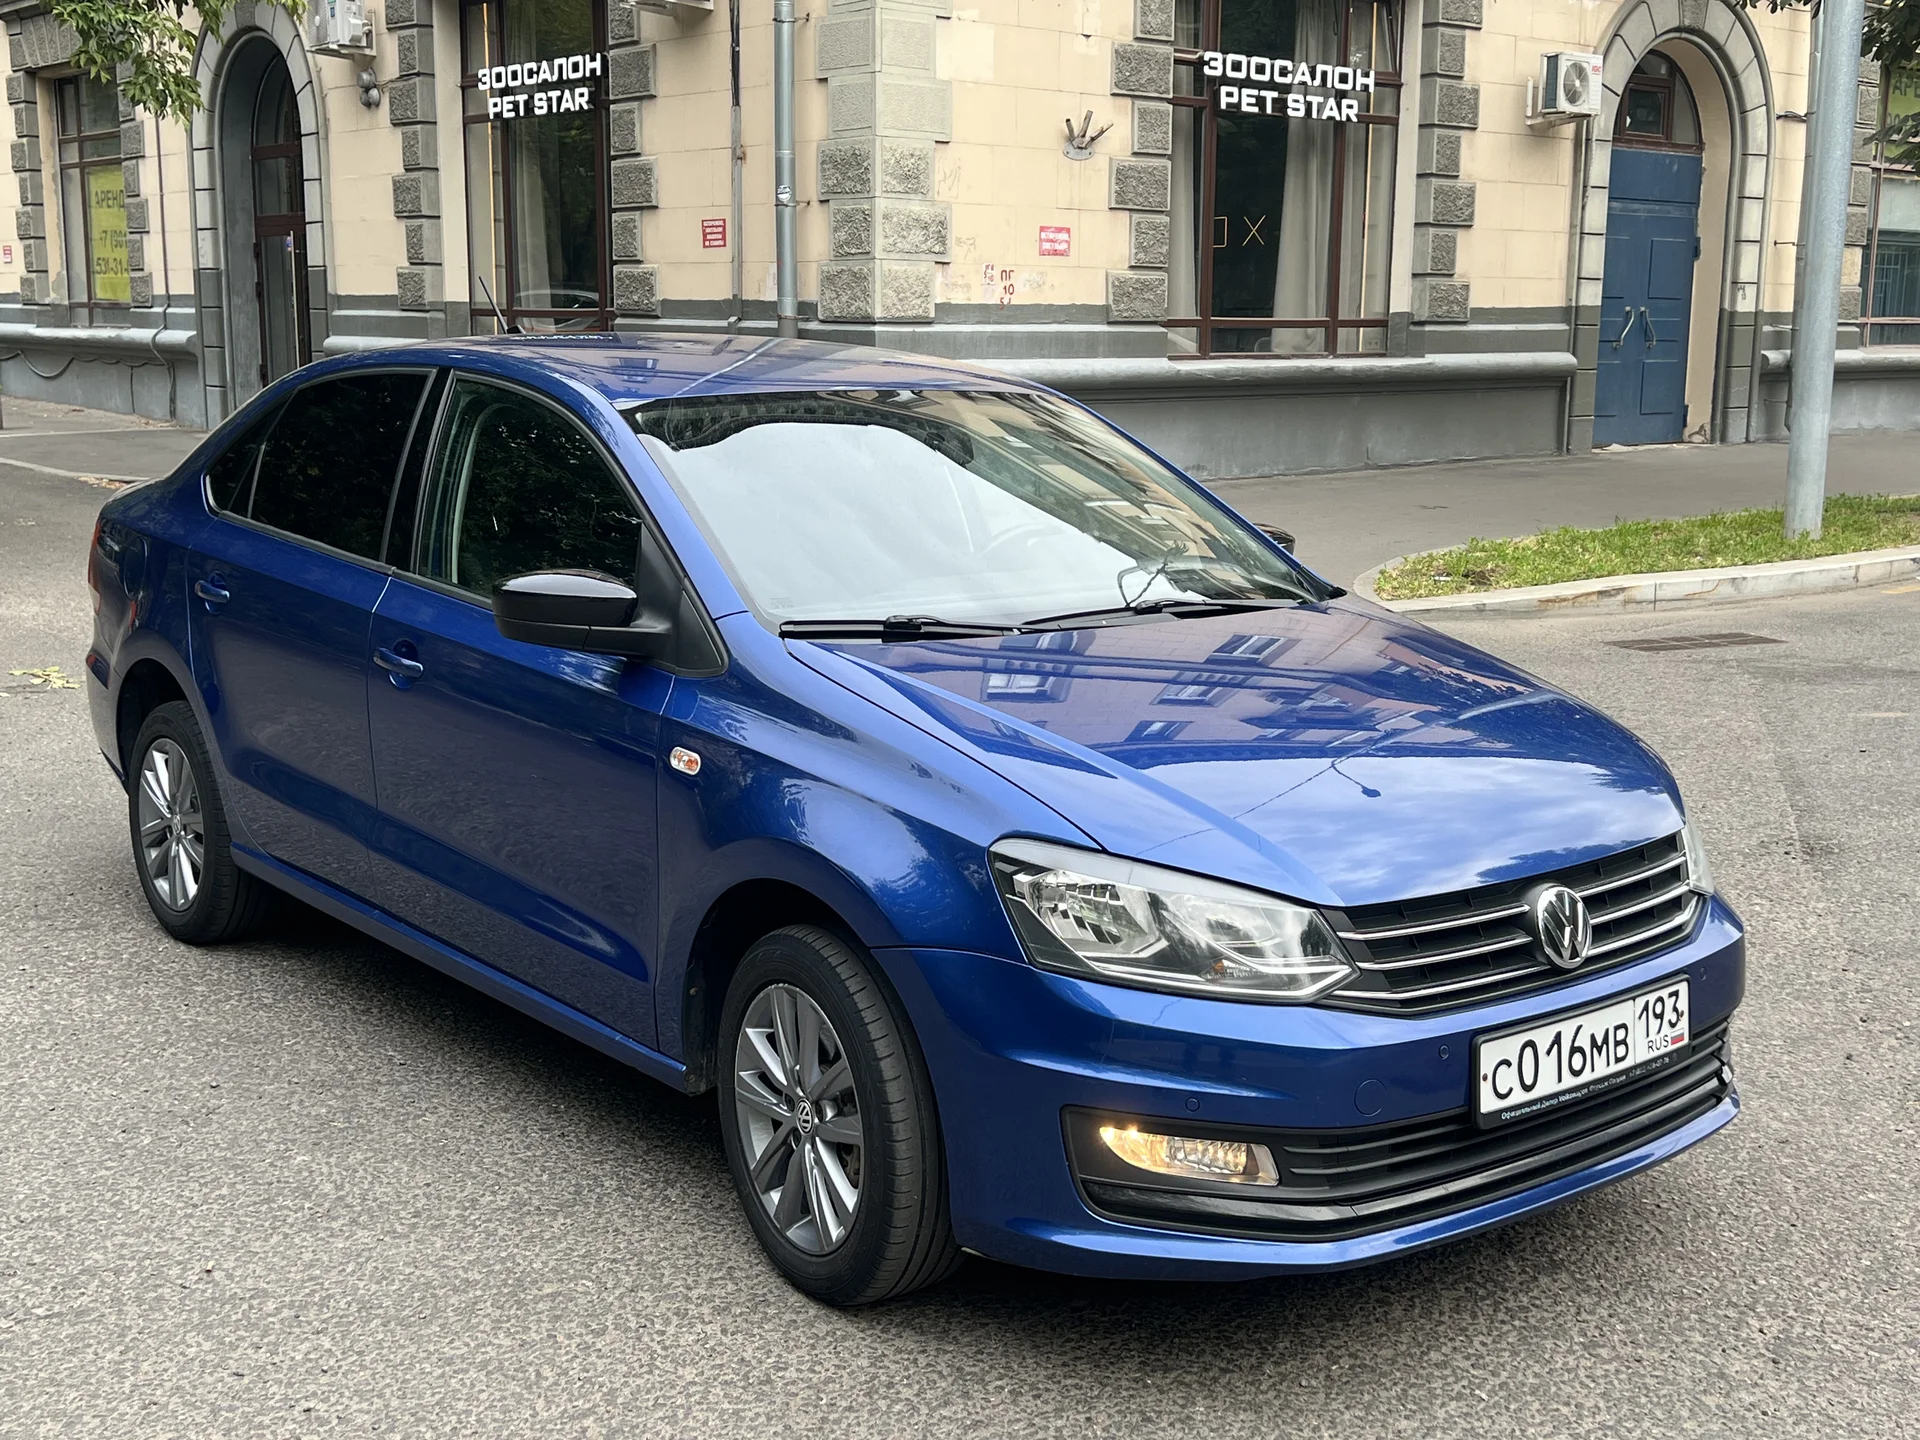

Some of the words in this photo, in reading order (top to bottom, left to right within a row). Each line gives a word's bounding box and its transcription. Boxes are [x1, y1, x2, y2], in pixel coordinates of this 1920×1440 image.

[478, 53, 601, 90] ЗООСАЛОН
[1203, 51, 1375, 92] ЗООСАЛОН
[489, 94, 528, 119] PET
[534, 87, 589, 115] STAR
[1220, 86, 1278, 114] PET
[1287, 94, 1358, 122] STAR
[1637, 989, 1680, 1039] 193
[1647, 1034, 1670, 1055] RUS
